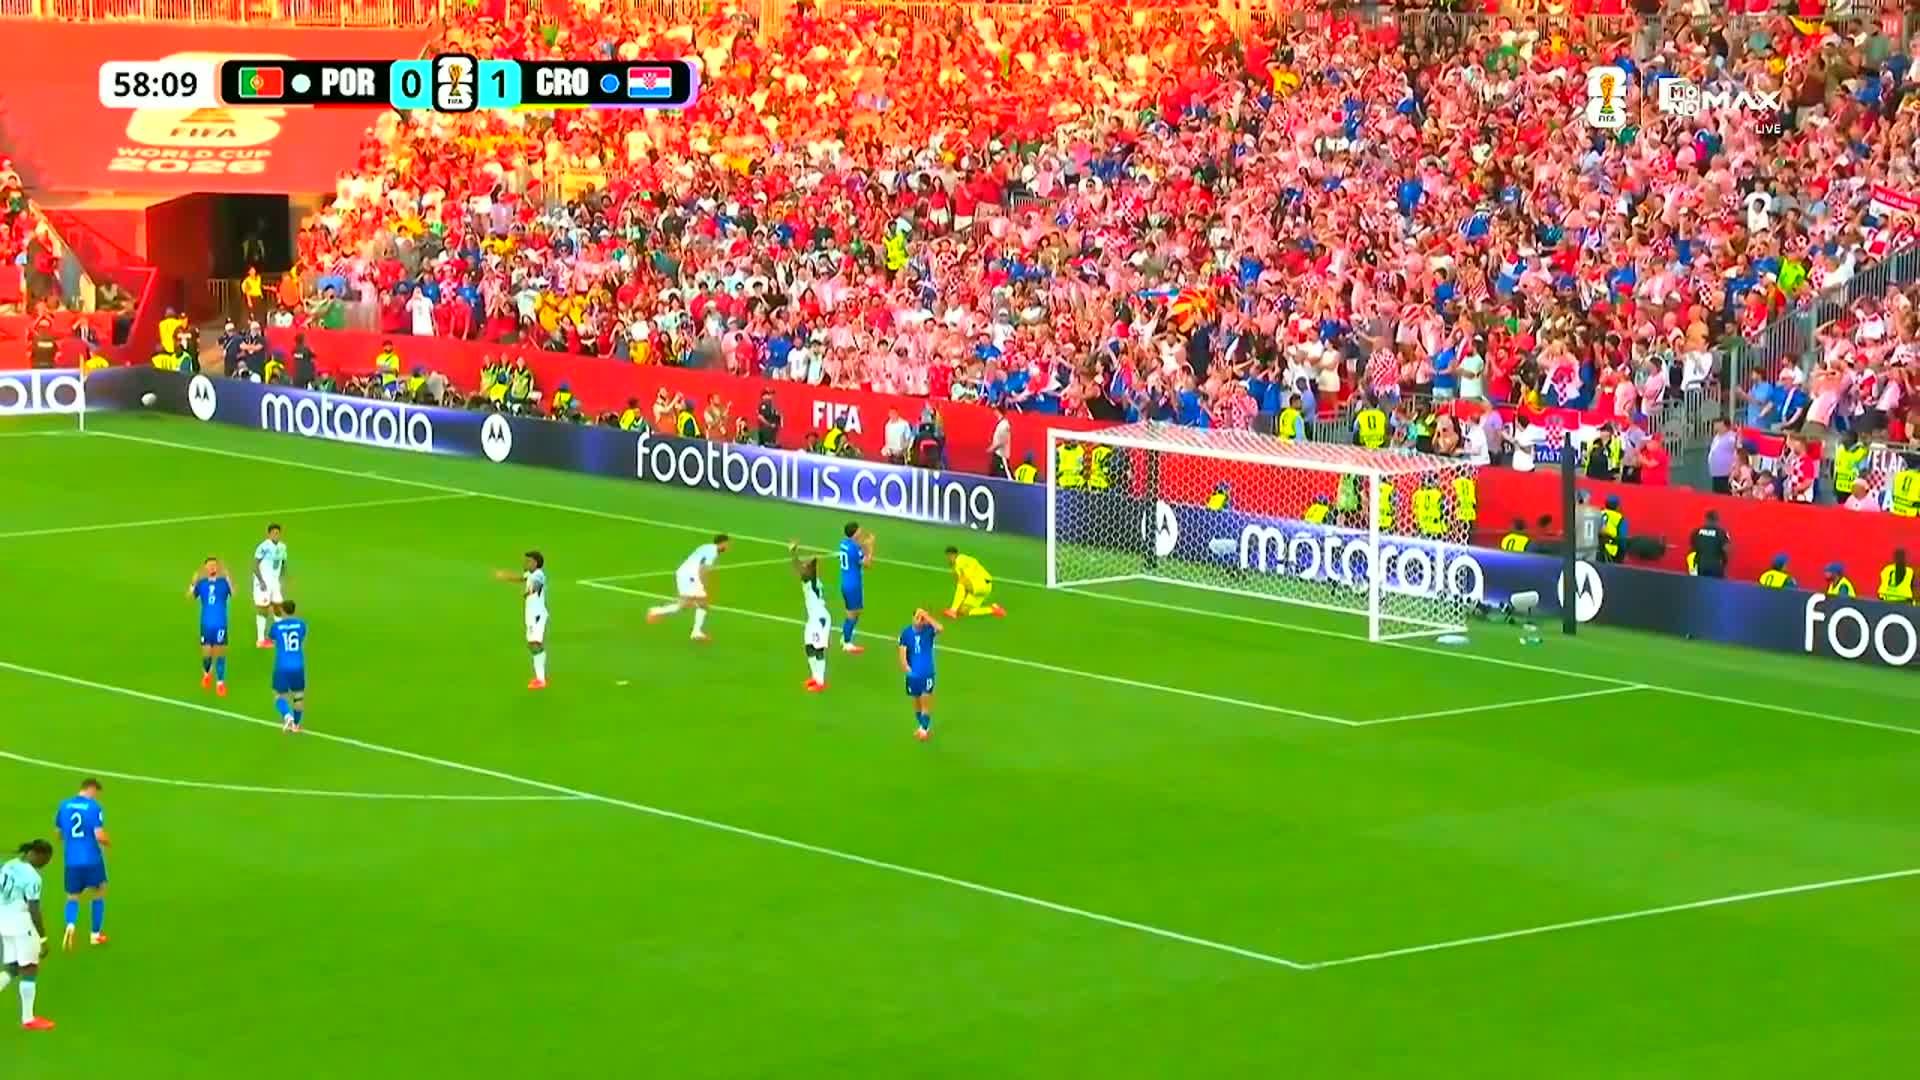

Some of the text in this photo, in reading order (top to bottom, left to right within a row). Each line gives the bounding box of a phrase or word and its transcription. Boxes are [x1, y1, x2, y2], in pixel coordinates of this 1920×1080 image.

[169, 128, 237, 138] FIFA
[107, 158, 267, 175] 2026
[117, 147, 273, 160] WORLD CUP
[261, 392, 433, 452] motorola
[812, 400, 862, 434] FIFA
[636, 432, 996, 532] football is calling
[1240, 524, 1484, 602] motorola
[282, 631, 299, 652] 16
[1805, 593, 1918, 666] foo
[70, 812, 84, 837] 2
